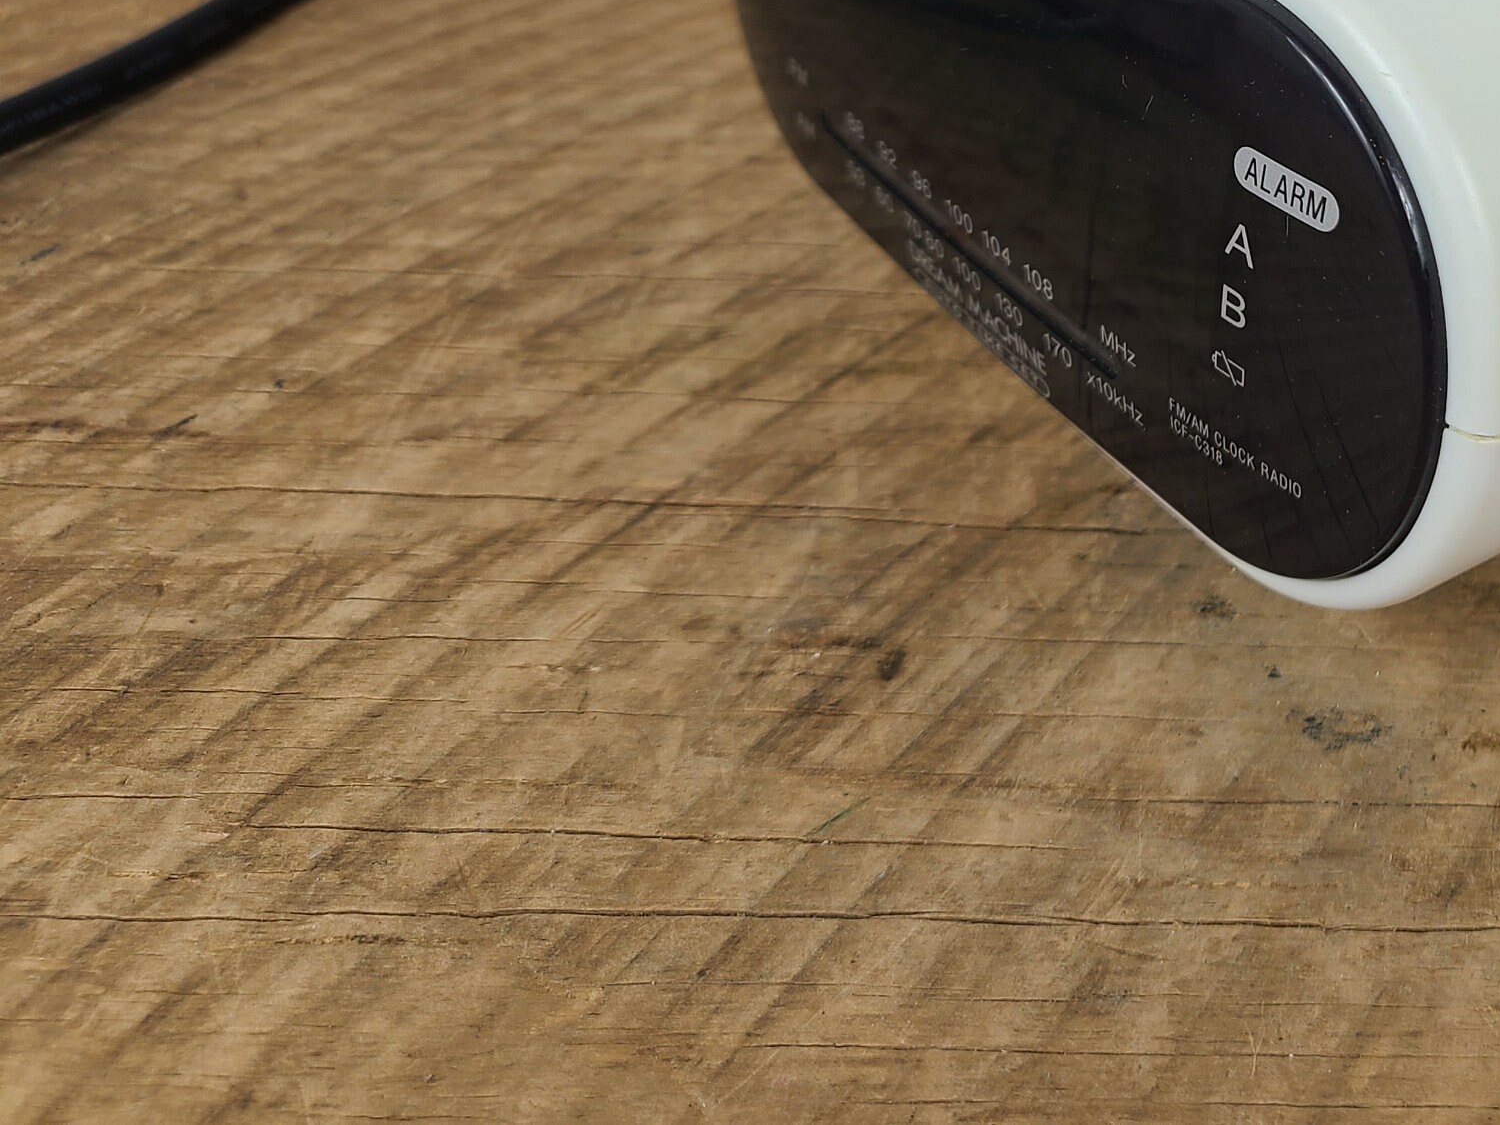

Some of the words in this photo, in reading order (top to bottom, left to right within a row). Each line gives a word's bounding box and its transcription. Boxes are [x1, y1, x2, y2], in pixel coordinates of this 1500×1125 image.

[1244, 156, 1327, 224] ALARM
[944, 199, 973, 235] 100
[982, 230, 1012, 266] 104
[1023, 264, 1054, 300] 108
[1101, 324, 1137, 367] MHz
[1225, 223, 1254, 270] A
[951, 256, 981, 291] 100
[995, 292, 1023, 327] 130
[1042, 332, 1073, 368] 170
[1087, 371, 1144, 427] x10kHz
[968, 293, 1048, 376] MACHINE
[1221, 283, 1246, 329] B
[1169, 397, 1209, 439] FM/AM
[1214, 430, 1256, 471] CLOCK
[1260, 461, 1302, 499] RADIO
[1170, 415, 1224, 466] ICF-C318
